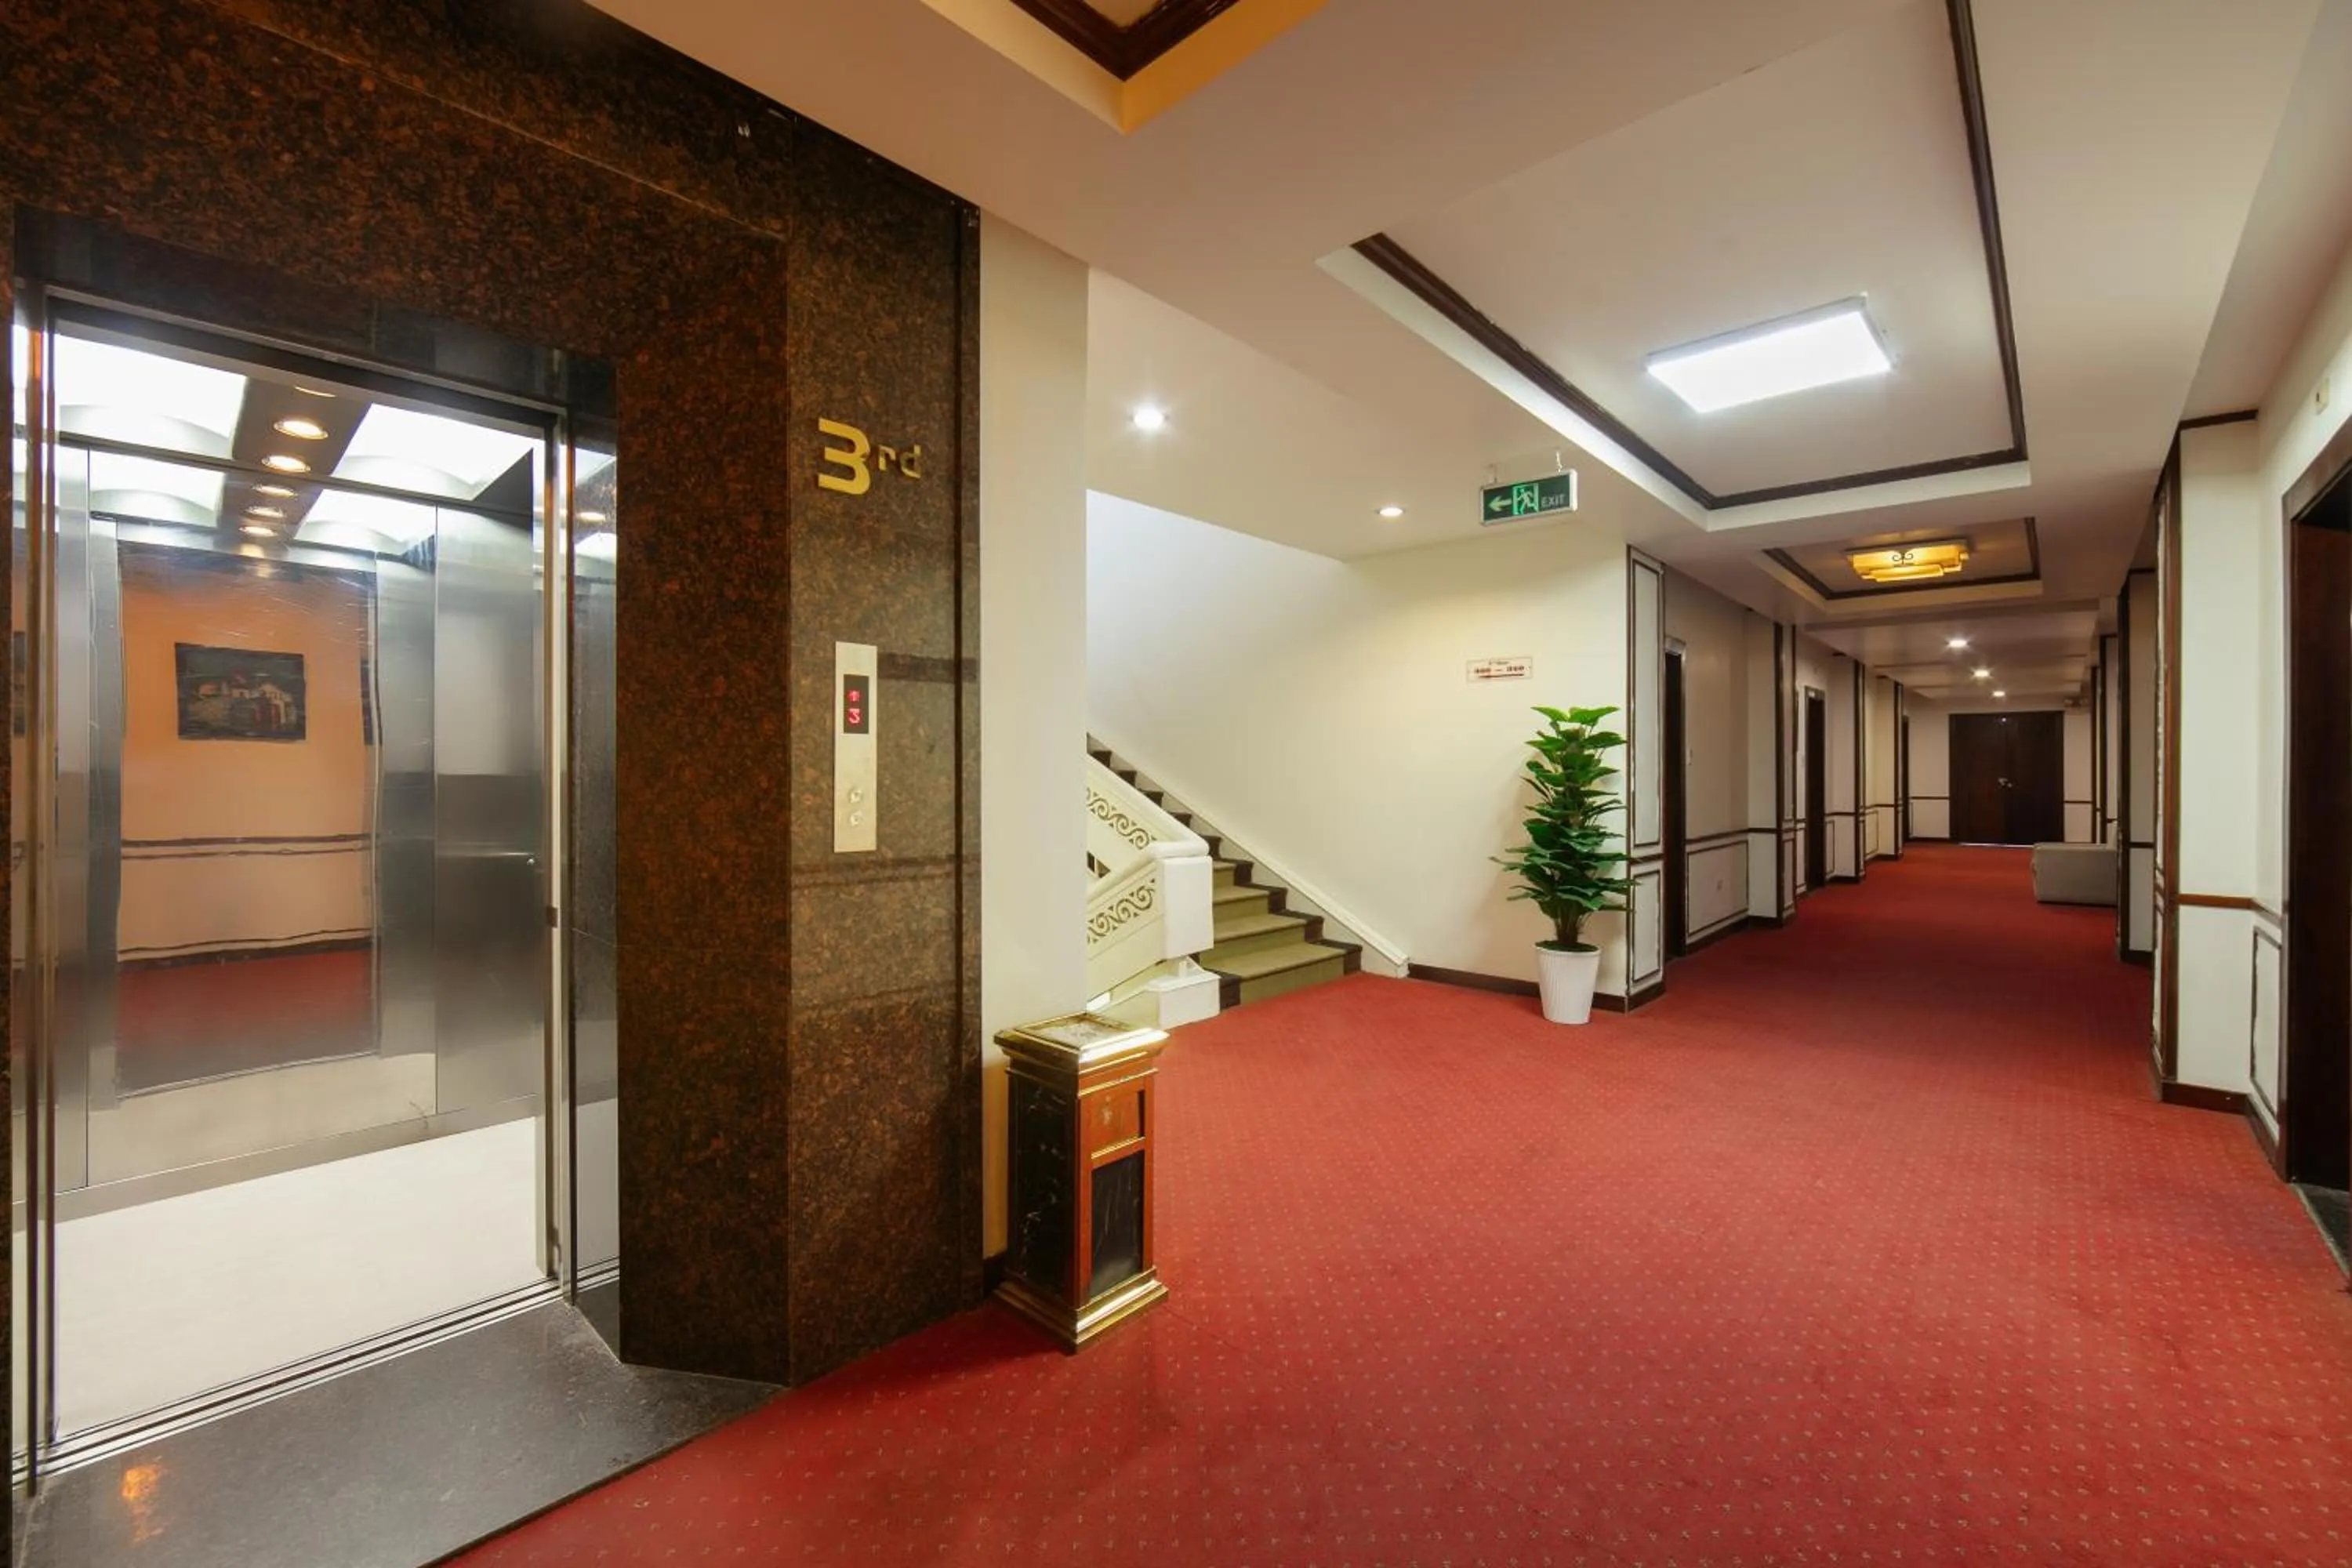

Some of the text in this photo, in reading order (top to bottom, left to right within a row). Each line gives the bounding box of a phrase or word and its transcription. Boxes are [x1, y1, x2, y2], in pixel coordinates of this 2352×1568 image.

[818, 417, 921, 495] 3rd
[1541, 494, 1565, 508] EXIT
[848, 709, 860, 724] 3
